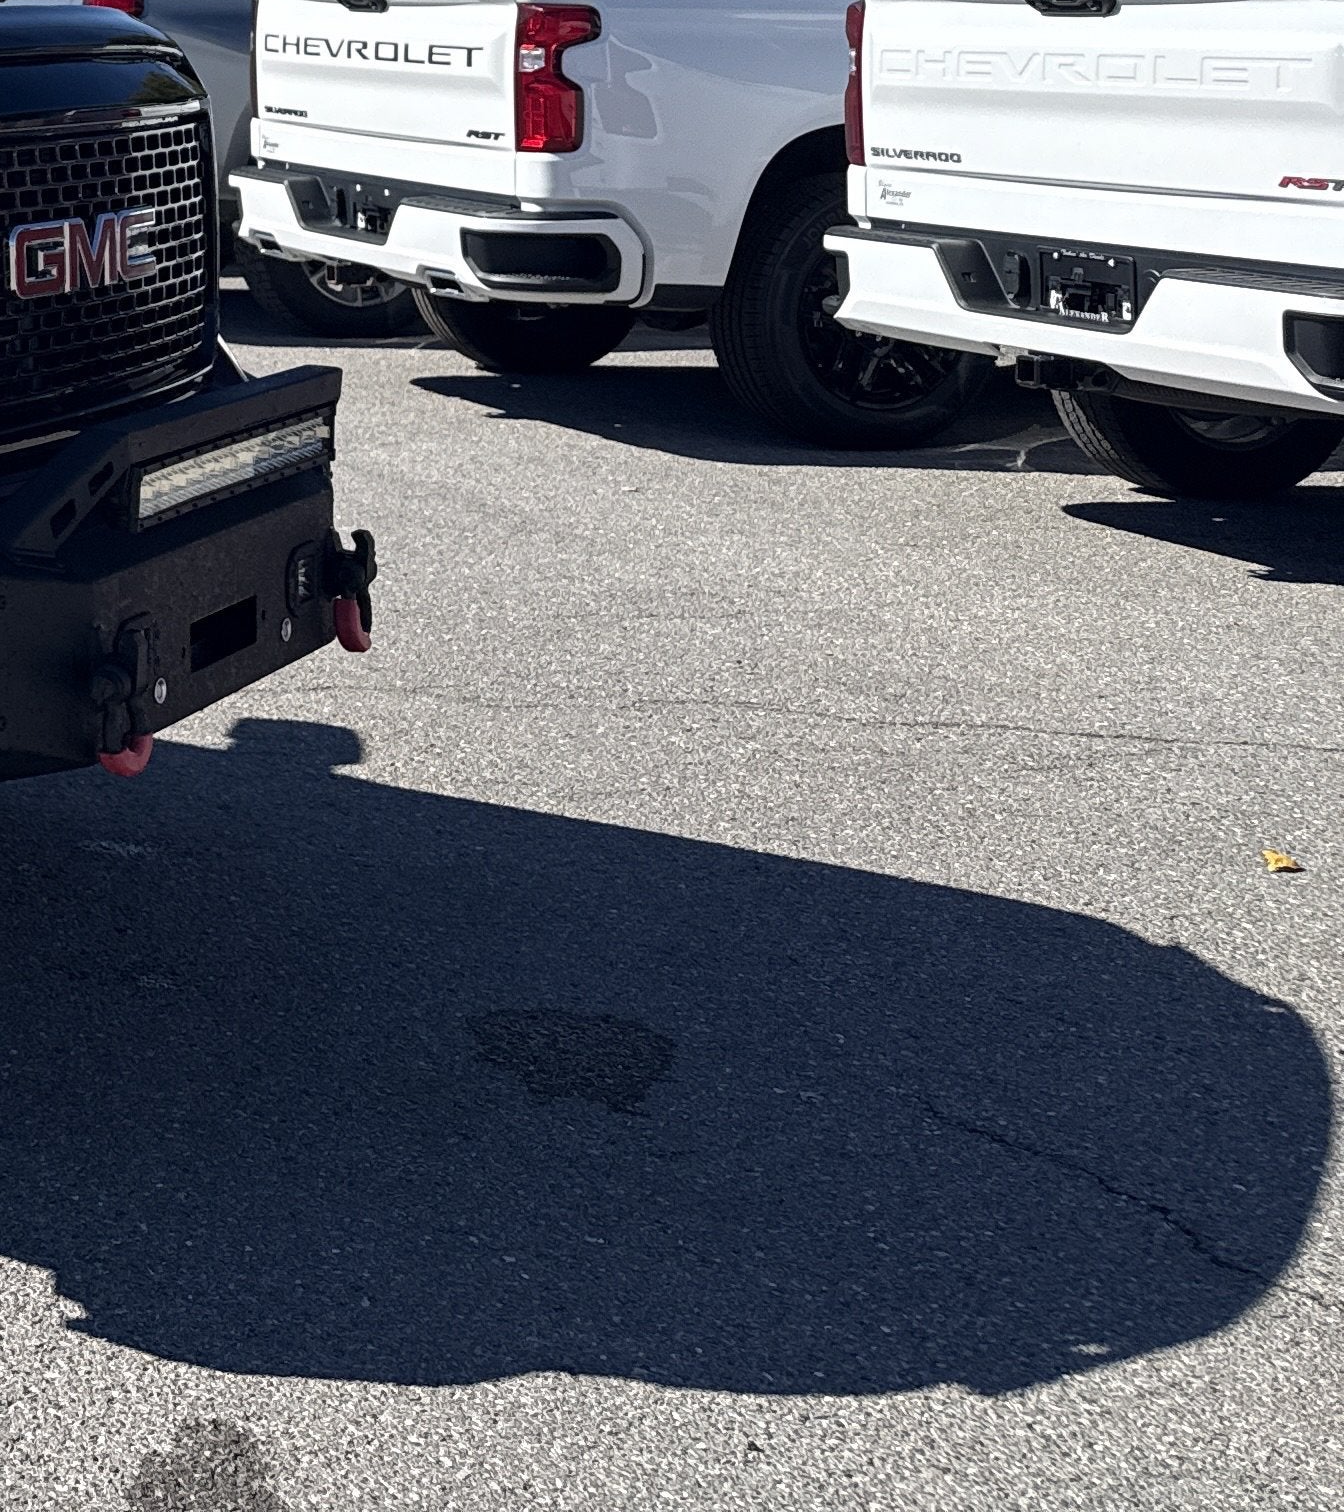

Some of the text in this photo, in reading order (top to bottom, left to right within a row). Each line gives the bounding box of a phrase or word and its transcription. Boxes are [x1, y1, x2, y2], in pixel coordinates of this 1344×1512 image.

[264, 34, 484, 67] CHEVROLET
[879, 48, 1314, 92] CHEVROLET
[466, 129, 506, 141] RST
[870, 146, 962, 163] SILVERADO
[1278, 176, 1344, 191] RST
[9, 207, 156, 300] GMC
